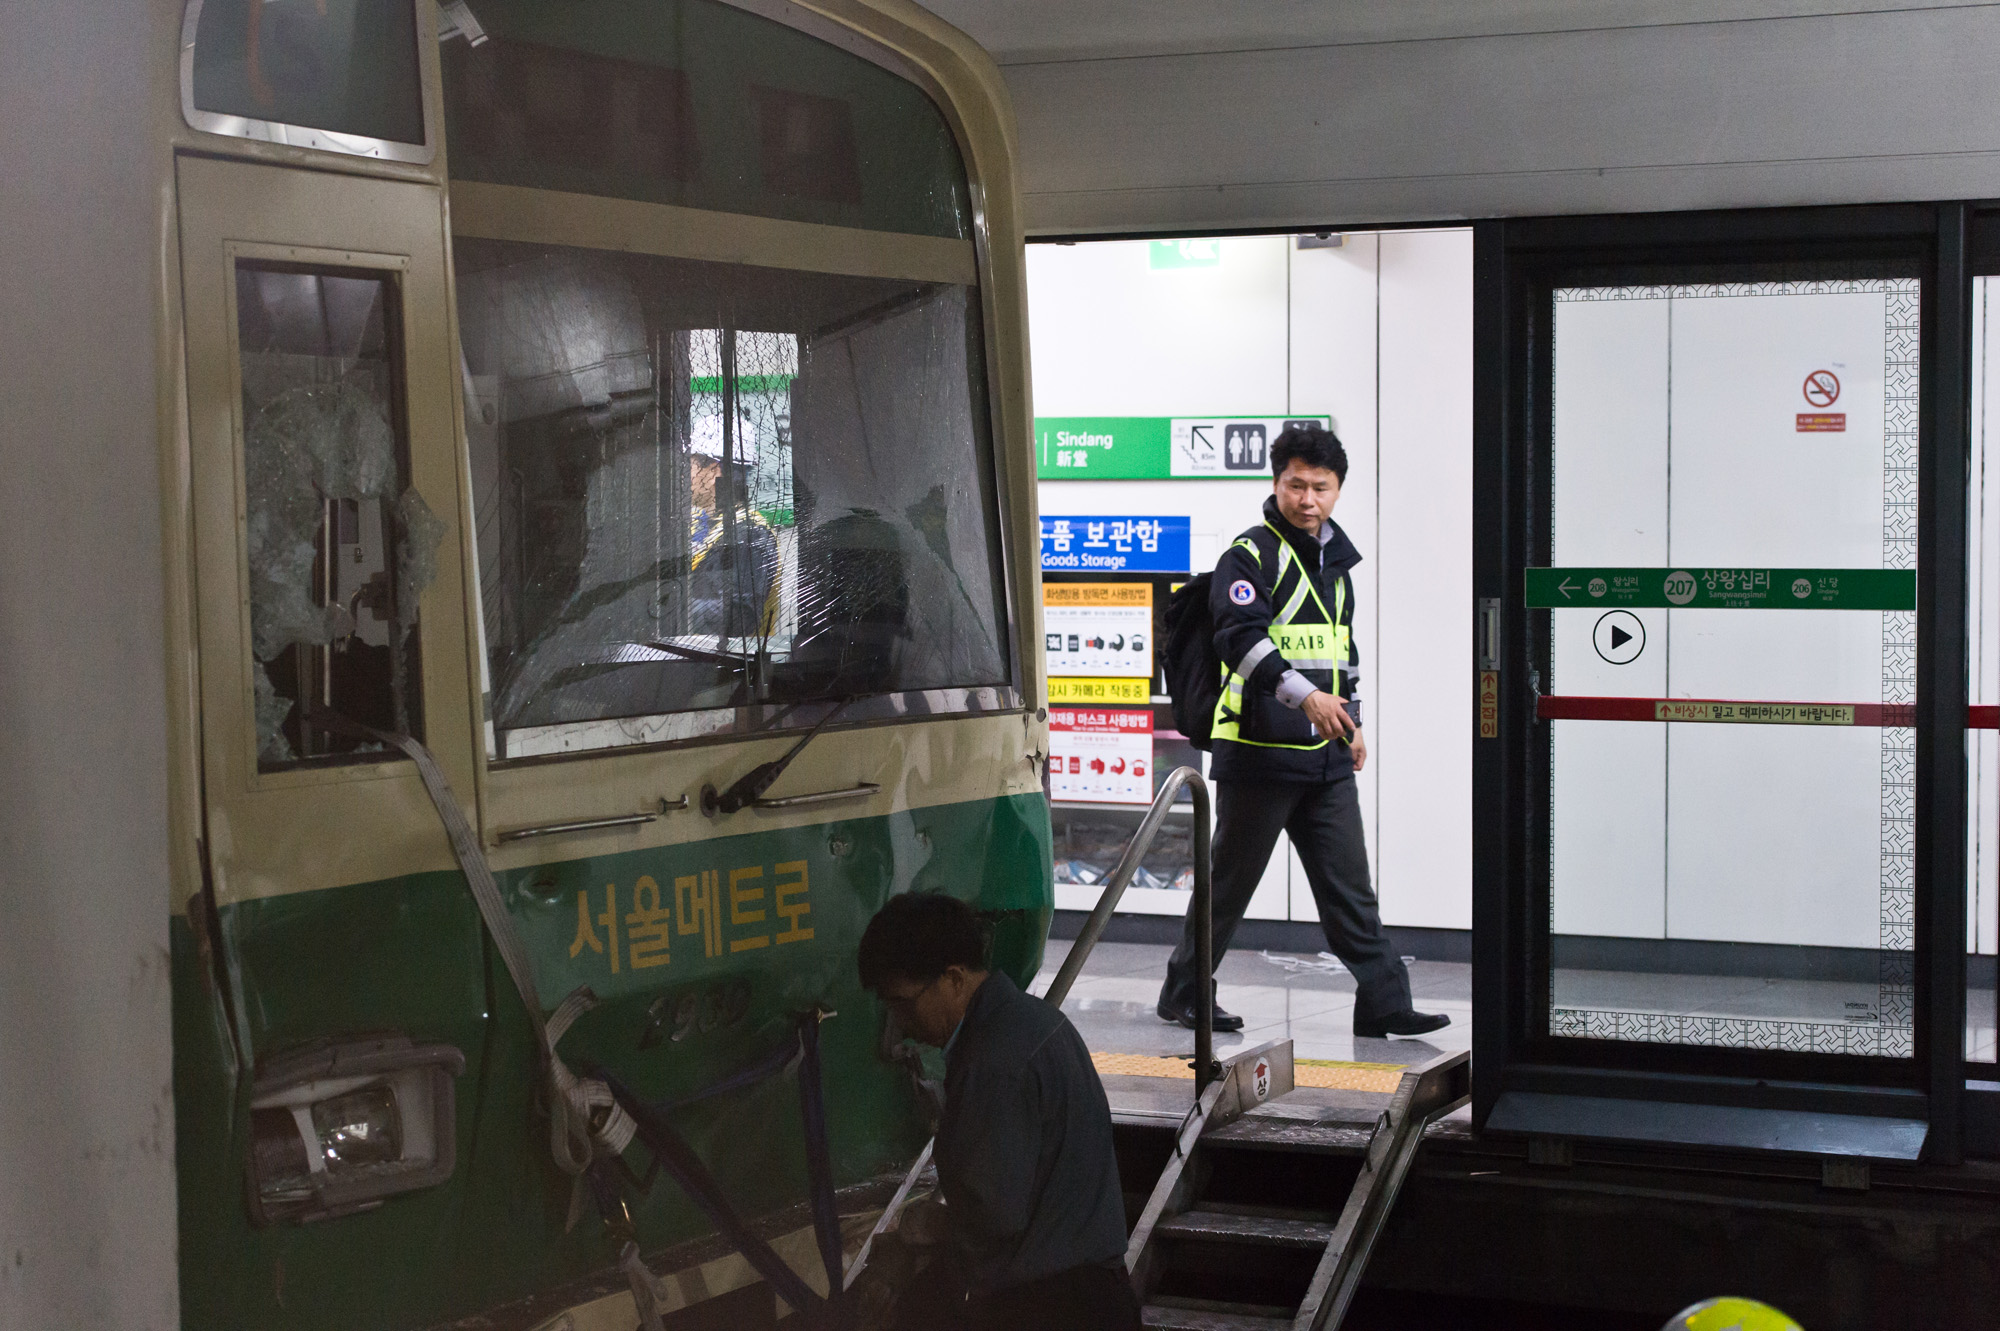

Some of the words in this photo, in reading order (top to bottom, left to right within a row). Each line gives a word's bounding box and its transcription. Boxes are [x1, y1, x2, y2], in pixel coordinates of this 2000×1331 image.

[1056, 431, 1113, 450] Sindang
[1083, 519, 1163, 552] 보관함
[1041, 553, 1079, 567] Goods
[1081, 553, 1126, 570] Storage
[1590, 583, 1606, 593] 208
[1613, 576, 1639, 587] 왕십리
[1666, 580, 1695, 596] 207
[1701, 570, 1770, 590] 상왕십리
[1708, 590, 1767, 599] Sangwangsimni
[1793, 584, 1811, 593] 206
[1280, 635, 1325, 650] RAIB
[1072, 685, 1105, 697] 카메라
[1110, 685, 1143, 698] 작동중
[1077, 713, 1107, 726] 마스크
[1108, 714, 1148, 728] 사용방법
[1481, 691, 1496, 736] 손잡이
[1674, 704, 1708, 719] 비상시
[1712, 706, 1735, 719] 밀고
[1739, 706, 1796, 721] 대피하시기
[1800, 707, 1850, 722] 바랍니다.
[569, 860, 814, 974] 서울메트로
[1257, 1077, 1267, 1096] 상
